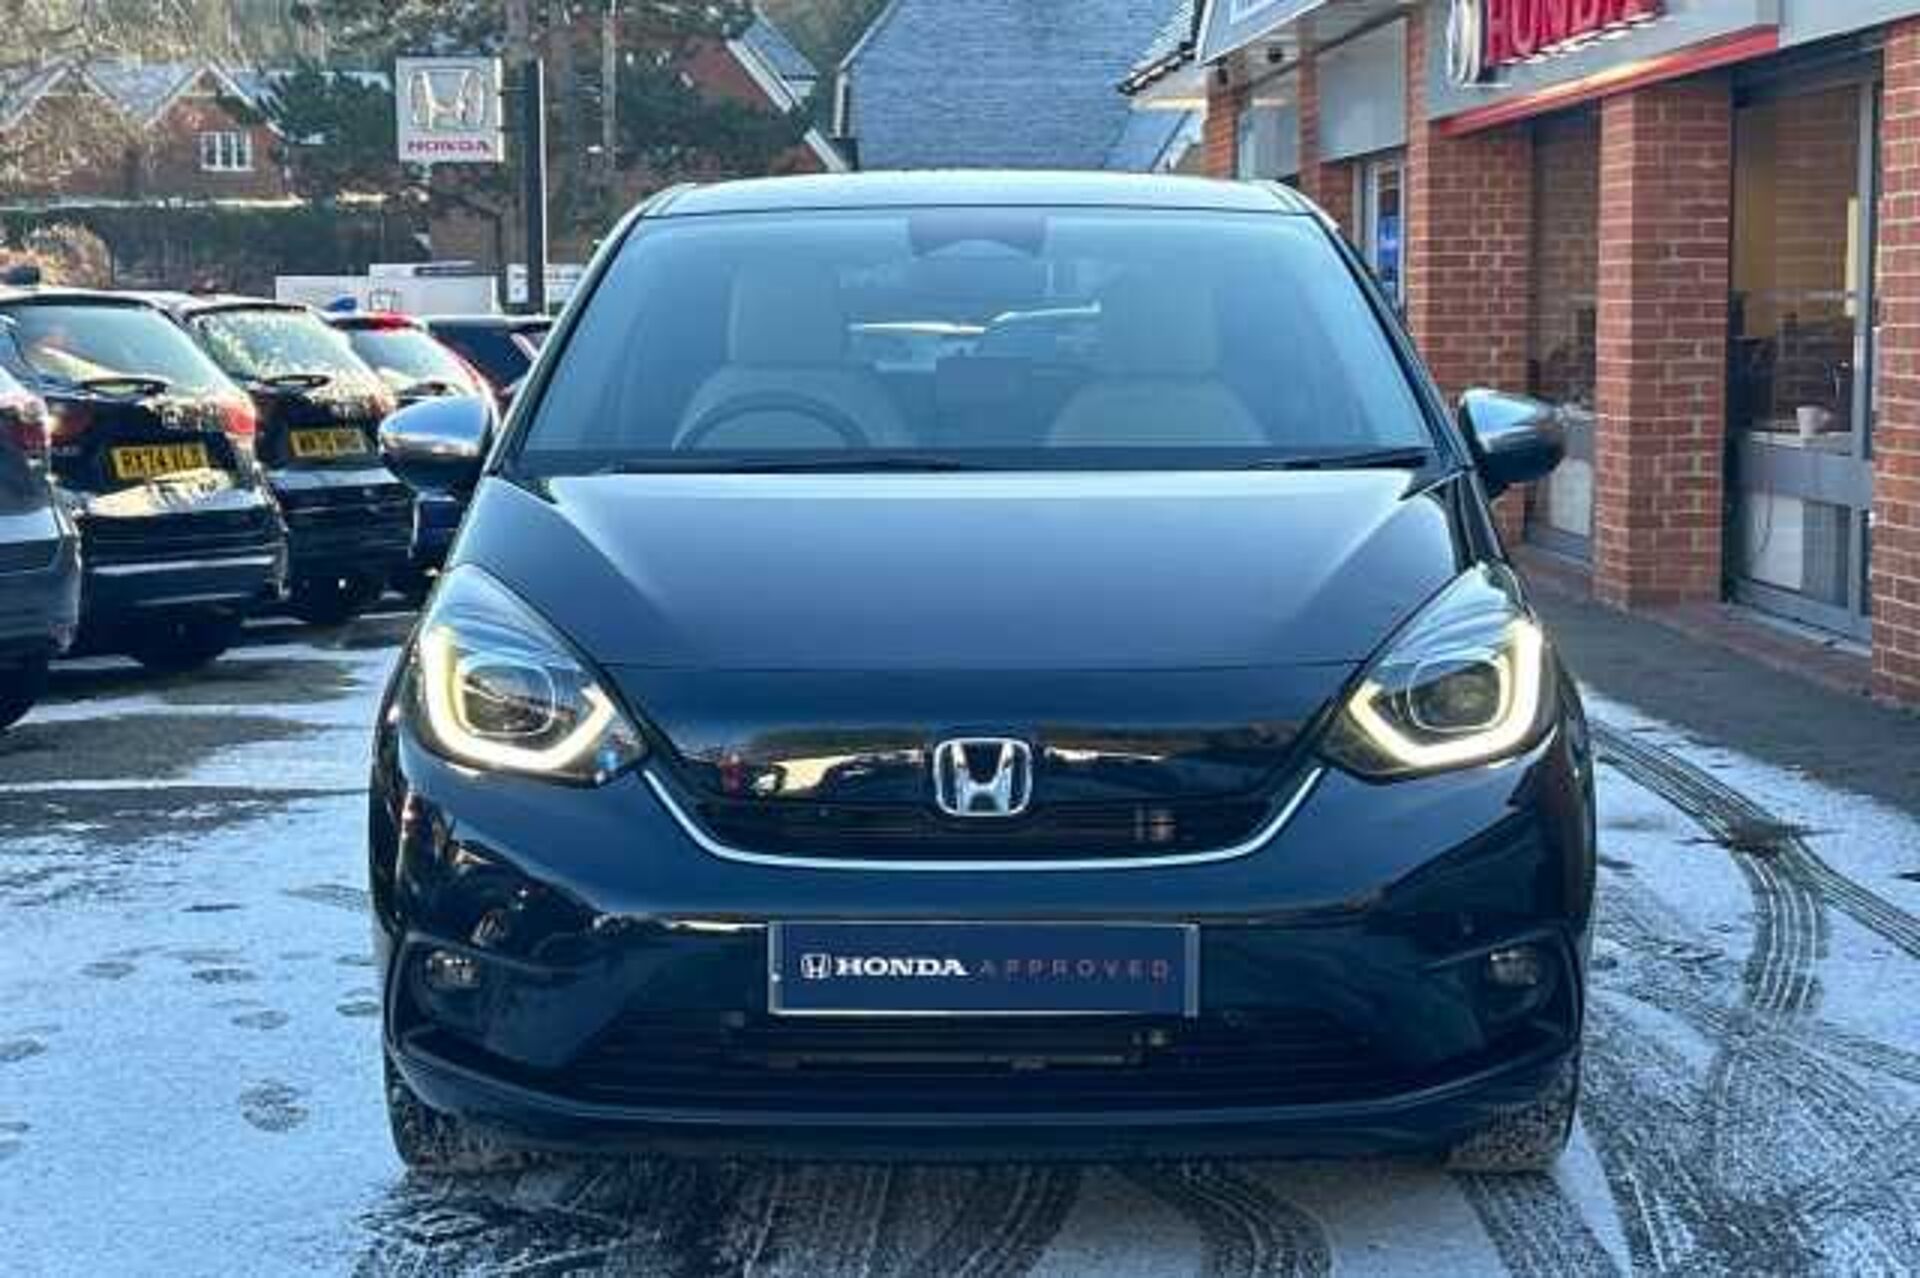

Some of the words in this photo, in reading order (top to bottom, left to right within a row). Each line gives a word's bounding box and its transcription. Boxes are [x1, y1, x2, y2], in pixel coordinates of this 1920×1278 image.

[1486, 0, 1662, 63] HON
[407, 140, 491, 152] HONDA
[835, 956, 970, 976] HONDA
[980, 959, 1169, 980] APPROVED
